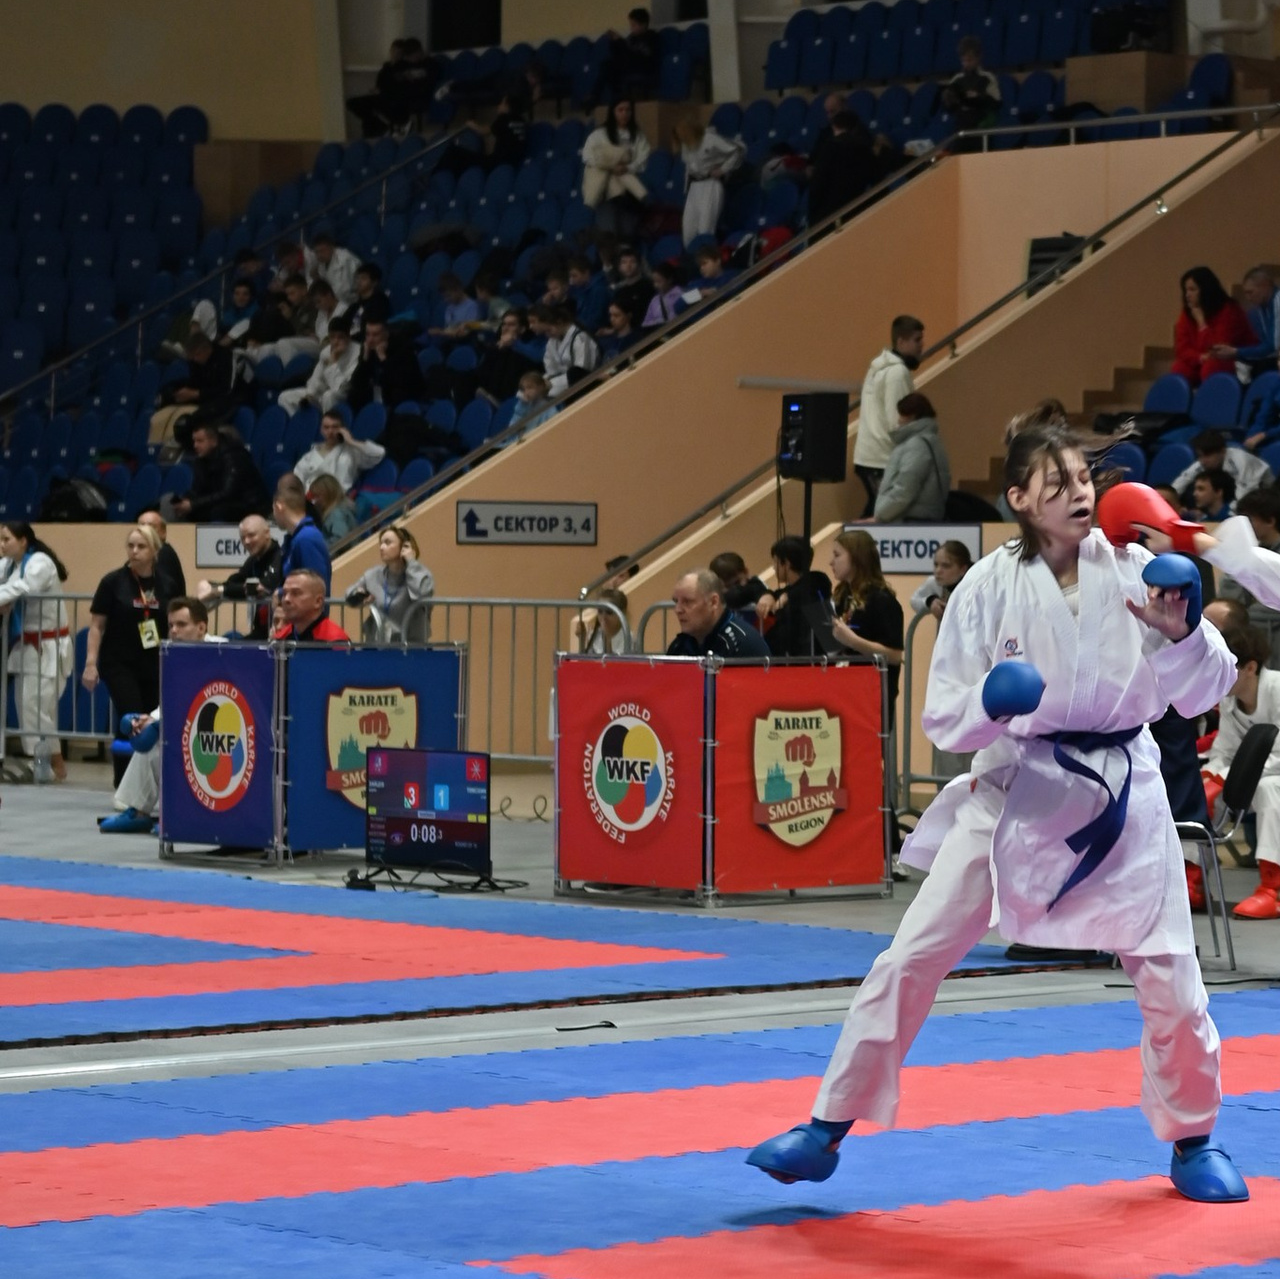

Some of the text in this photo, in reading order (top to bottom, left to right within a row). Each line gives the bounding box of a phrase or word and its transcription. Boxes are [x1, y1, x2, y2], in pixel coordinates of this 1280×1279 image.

[493, 516, 591, 535] СЕКТОР 3, 4
[875, 540, 940, 559] ЕКТОР
[203, 682, 238, 700] WORLD
[348, 695, 398, 707] KARATE
[607, 703, 651, 723] WORLD
[774, 717, 822, 731] KARATE
[200, 733, 236, 754] WKF
[182, 718, 216, 811] FEDERATION
[241, 724, 256, 789] KARATE
[605, 758, 651, 782] WKF
[408, 786, 416, 806] 3
[438, 789, 445, 807] 1
[583, 742, 627, 844] FEDERATION
[658, 750, 676, 822] KARATE
[768, 791, 836, 821] SMOLENSK
[788, 816, 825, 834] REGION
